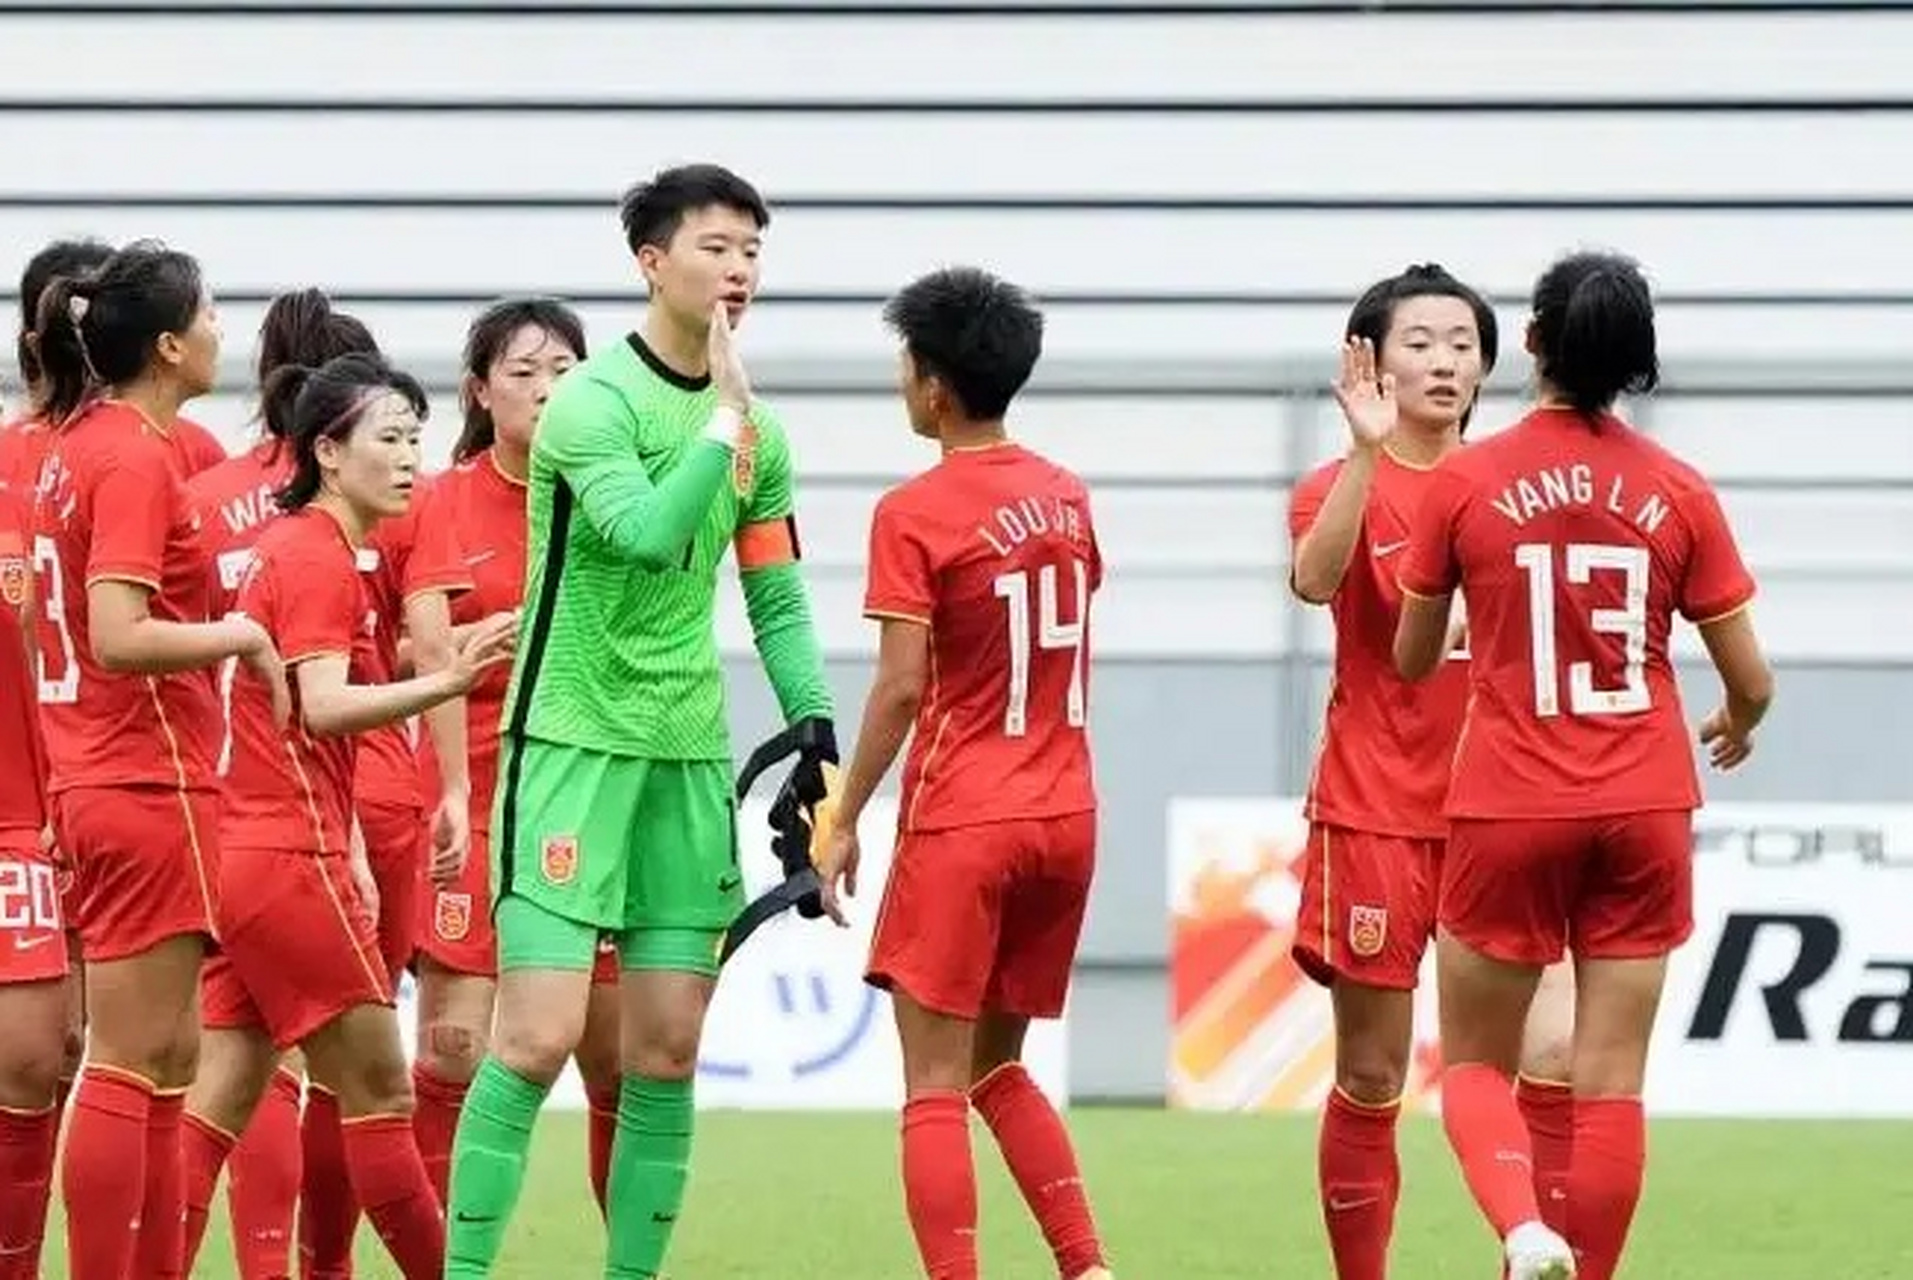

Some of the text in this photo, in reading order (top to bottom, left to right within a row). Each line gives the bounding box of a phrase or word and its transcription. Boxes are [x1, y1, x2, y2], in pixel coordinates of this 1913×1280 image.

[977, 496, 1049, 557] LOU
[1492, 463, 1594, 527] YANG
[994, 558, 1087, 738] 14
[1515, 543, 1651, 718] 13
[0, 861, 59, 930] 20
